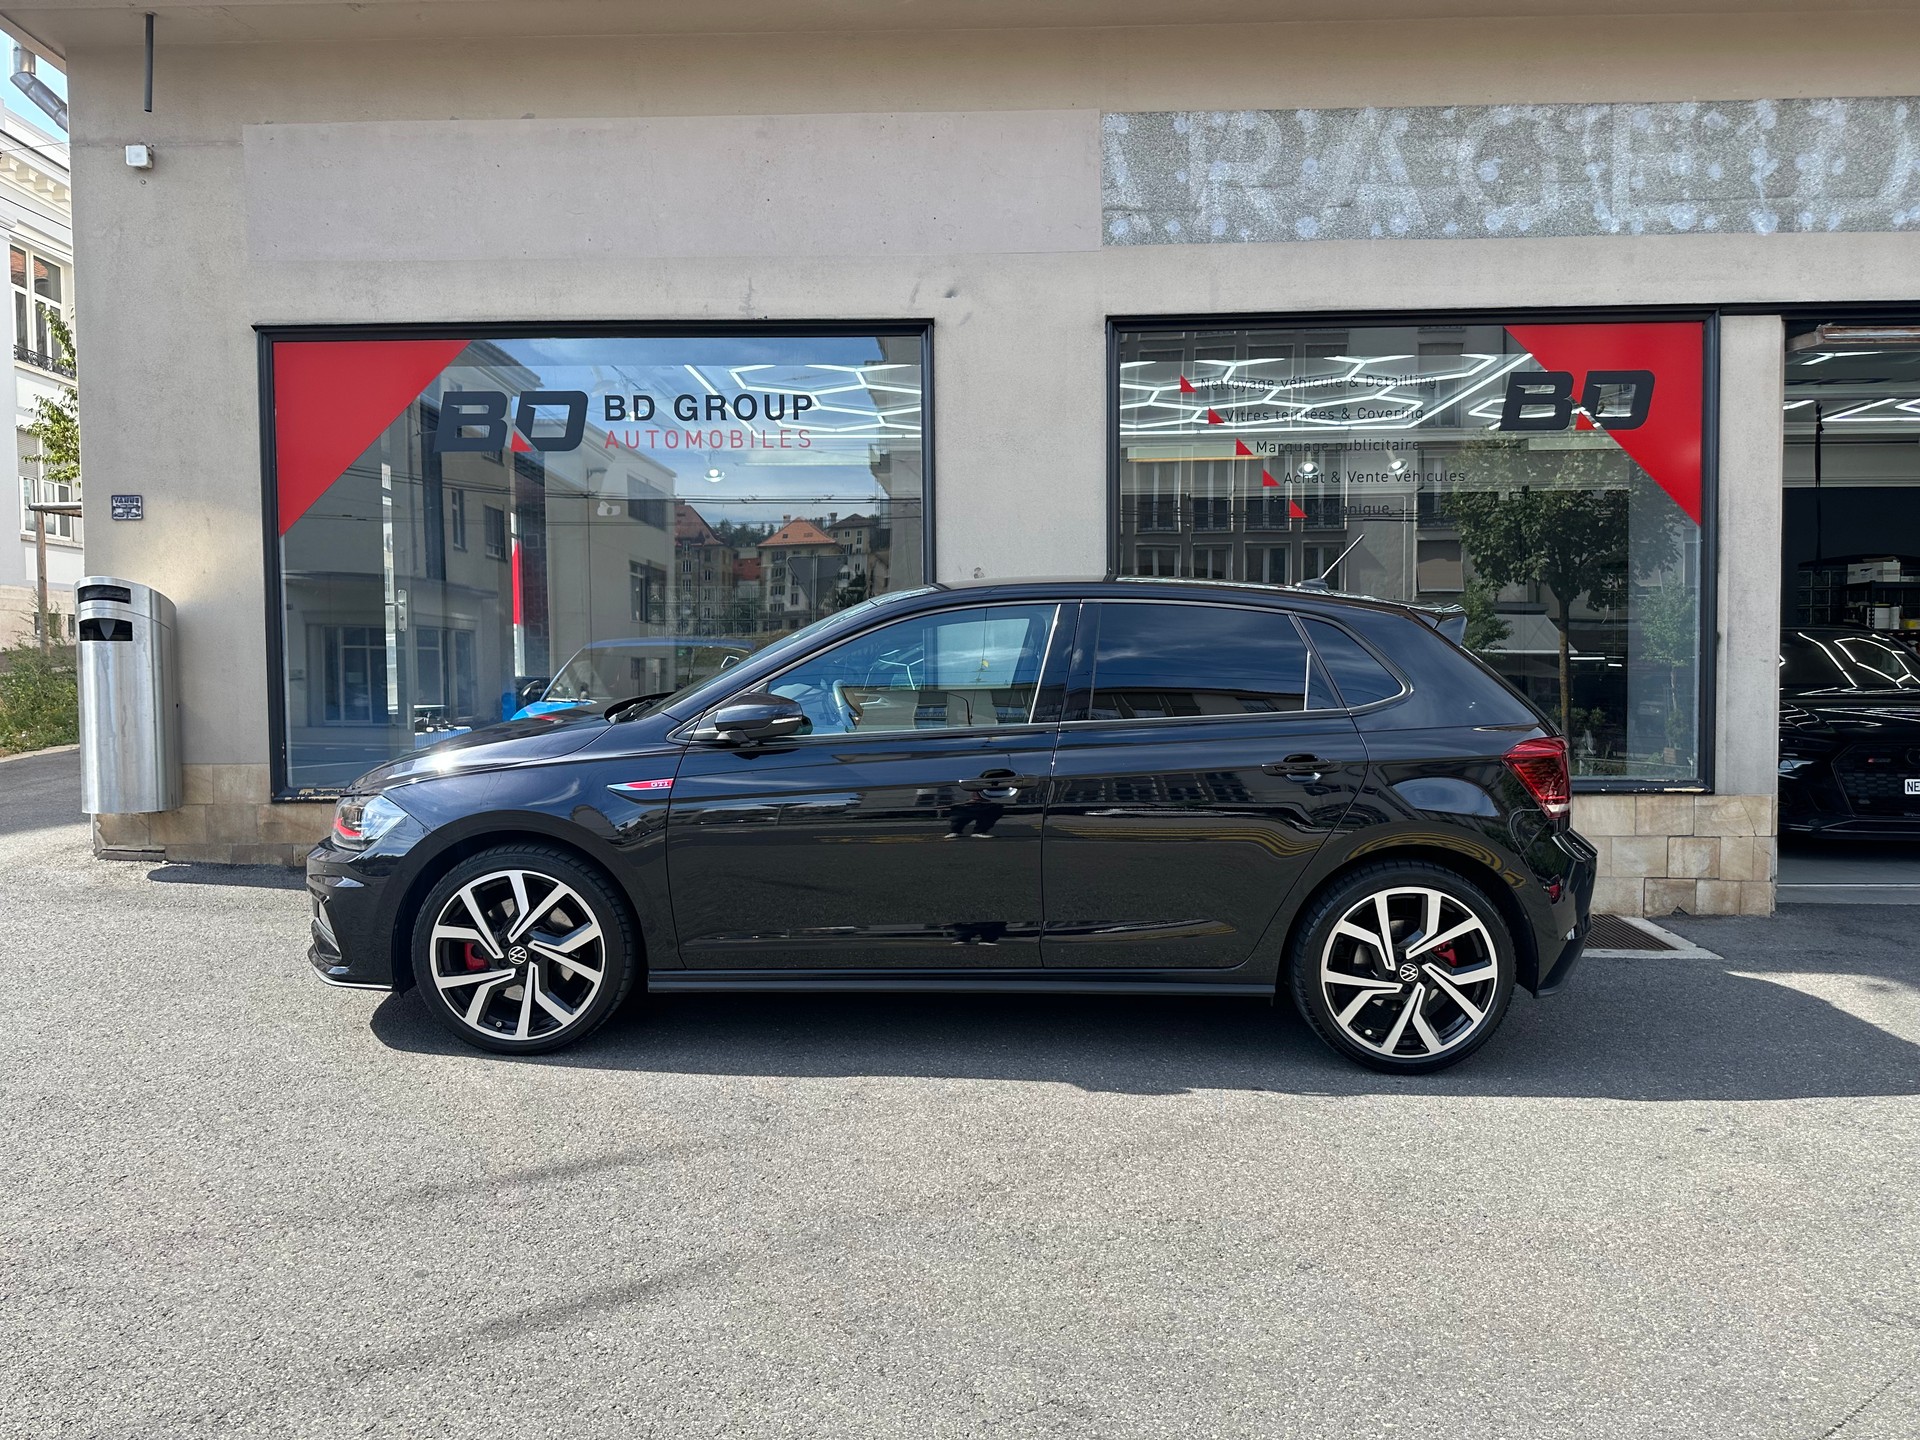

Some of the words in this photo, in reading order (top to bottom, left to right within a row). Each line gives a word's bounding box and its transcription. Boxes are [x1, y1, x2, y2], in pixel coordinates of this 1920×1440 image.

[1201, 378, 1275, 393] Nettoyage
[1281, 376, 1343, 389] véhicule
[1350, 375, 1359, 388] &
[605, 394, 655, 421] BD
[673, 394, 812, 421] GROUP
[1500, 370, 1655, 430] BD
[433, 391, 589, 452] BD
[1225, 408, 1269, 423] Vitres
[1275, 408, 1335, 421] teintées
[1341, 407, 1351, 420] &
[1357, 406, 1424, 422] Covering
[604, 429, 812, 449] AUTOMOBILES
[1256, 440, 1329, 455] Marquage
[1335, 438, 1420, 453] publicitaire
[1284, 471, 1325, 484] Achat
[1331, 471, 1341, 483] &
[1347, 470, 1389, 483] Vente
[1395, 469, 1466, 483] véhicules
